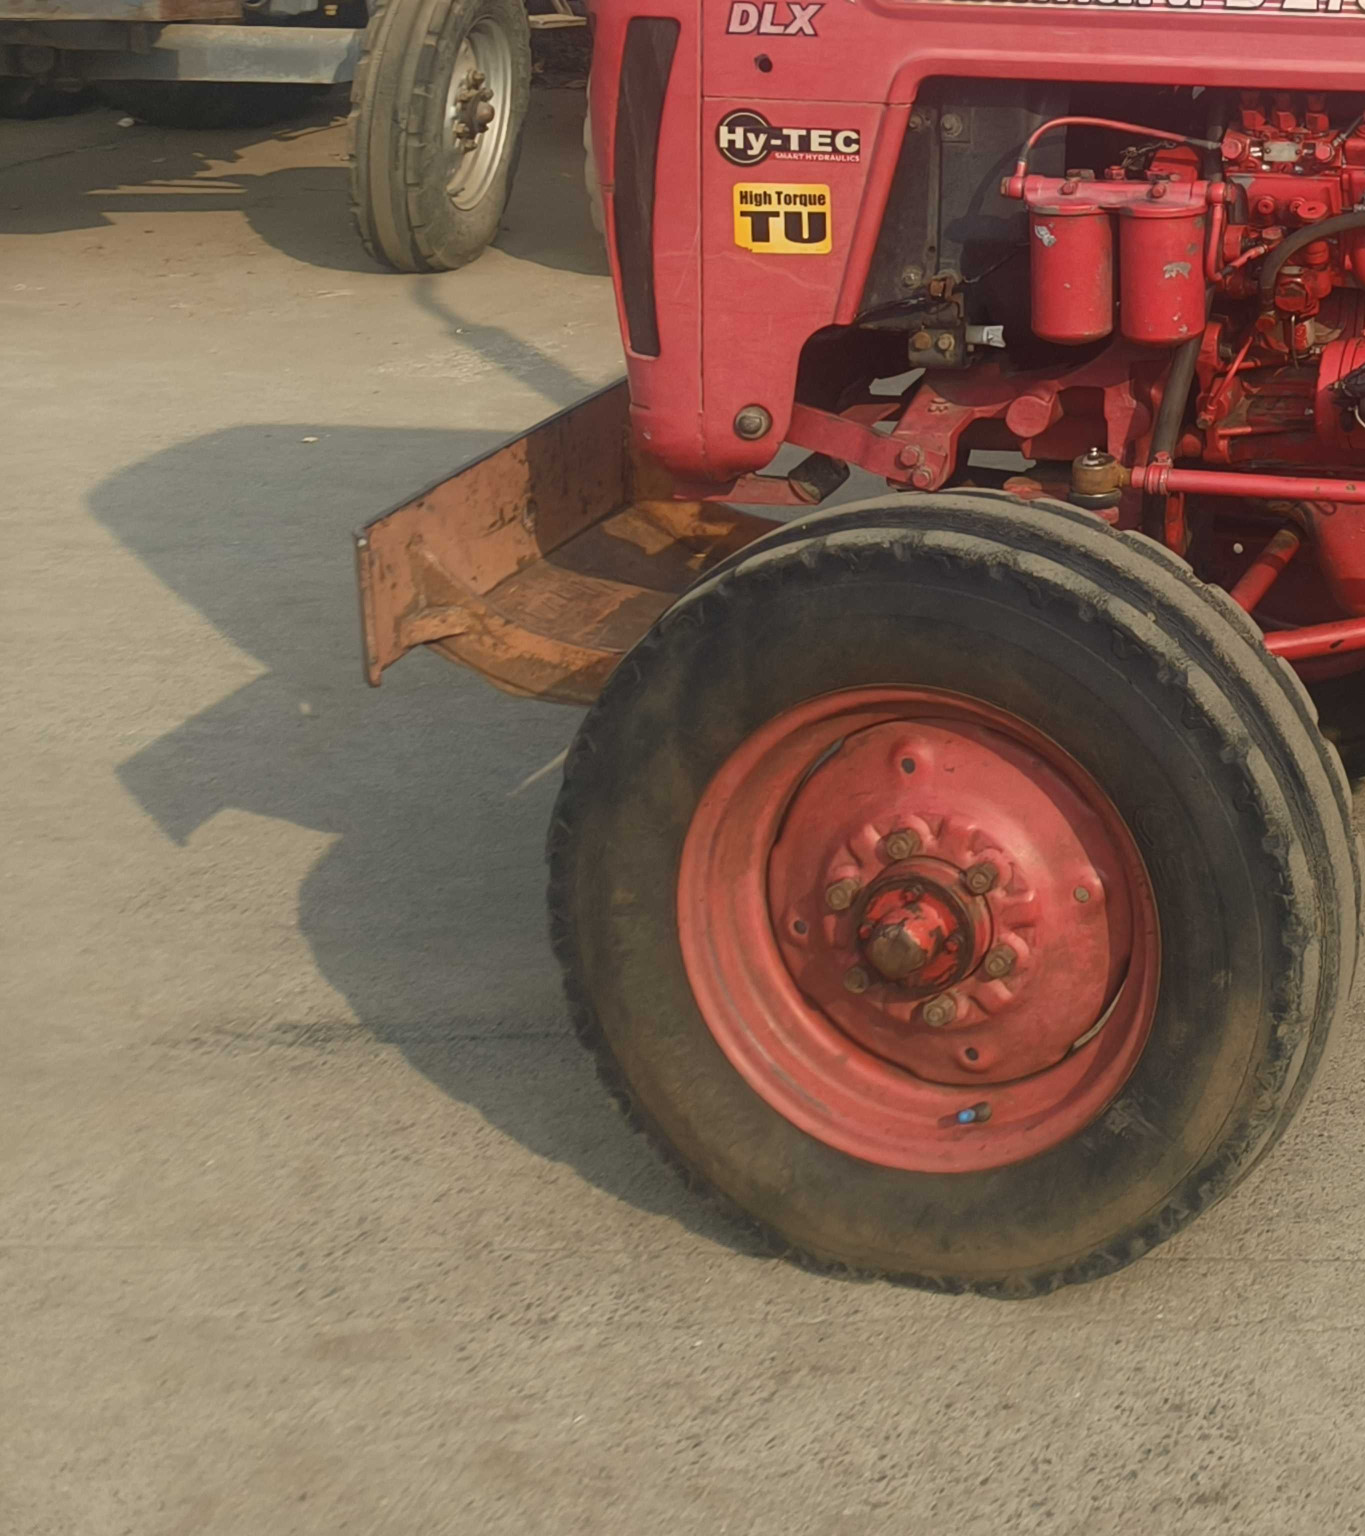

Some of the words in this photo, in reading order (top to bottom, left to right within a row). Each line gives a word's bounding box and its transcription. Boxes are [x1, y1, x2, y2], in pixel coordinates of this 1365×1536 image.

[725, 1, 826, 37] DLX
[719, 125, 860, 156] Hy-TEC
[775, 152, 804, 161] SMART
[805, 153, 860, 162] HYDRAULICS
[739, 190, 772, 207] High
[775, 190, 826, 208] Torque
[739, 210, 827, 244] TU
